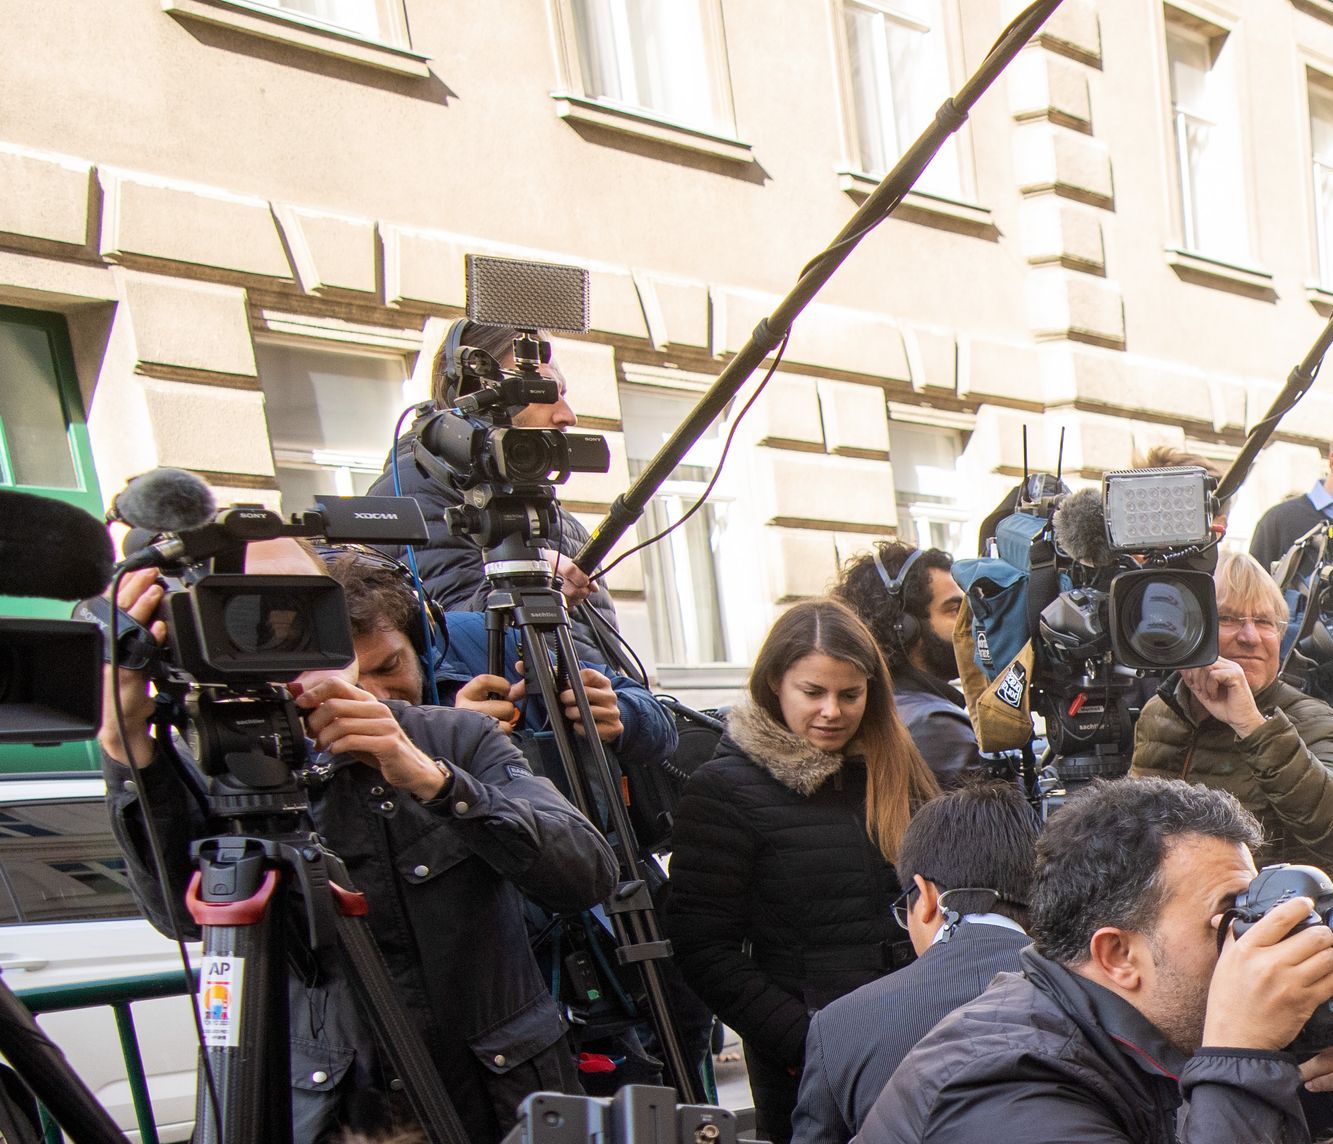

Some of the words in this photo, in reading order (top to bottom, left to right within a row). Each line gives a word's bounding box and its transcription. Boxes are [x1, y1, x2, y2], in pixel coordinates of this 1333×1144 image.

[354, 512, 398, 520] XDCAM
[80, 607, 108, 629] SONY
[209, 962, 231, 976] AP
